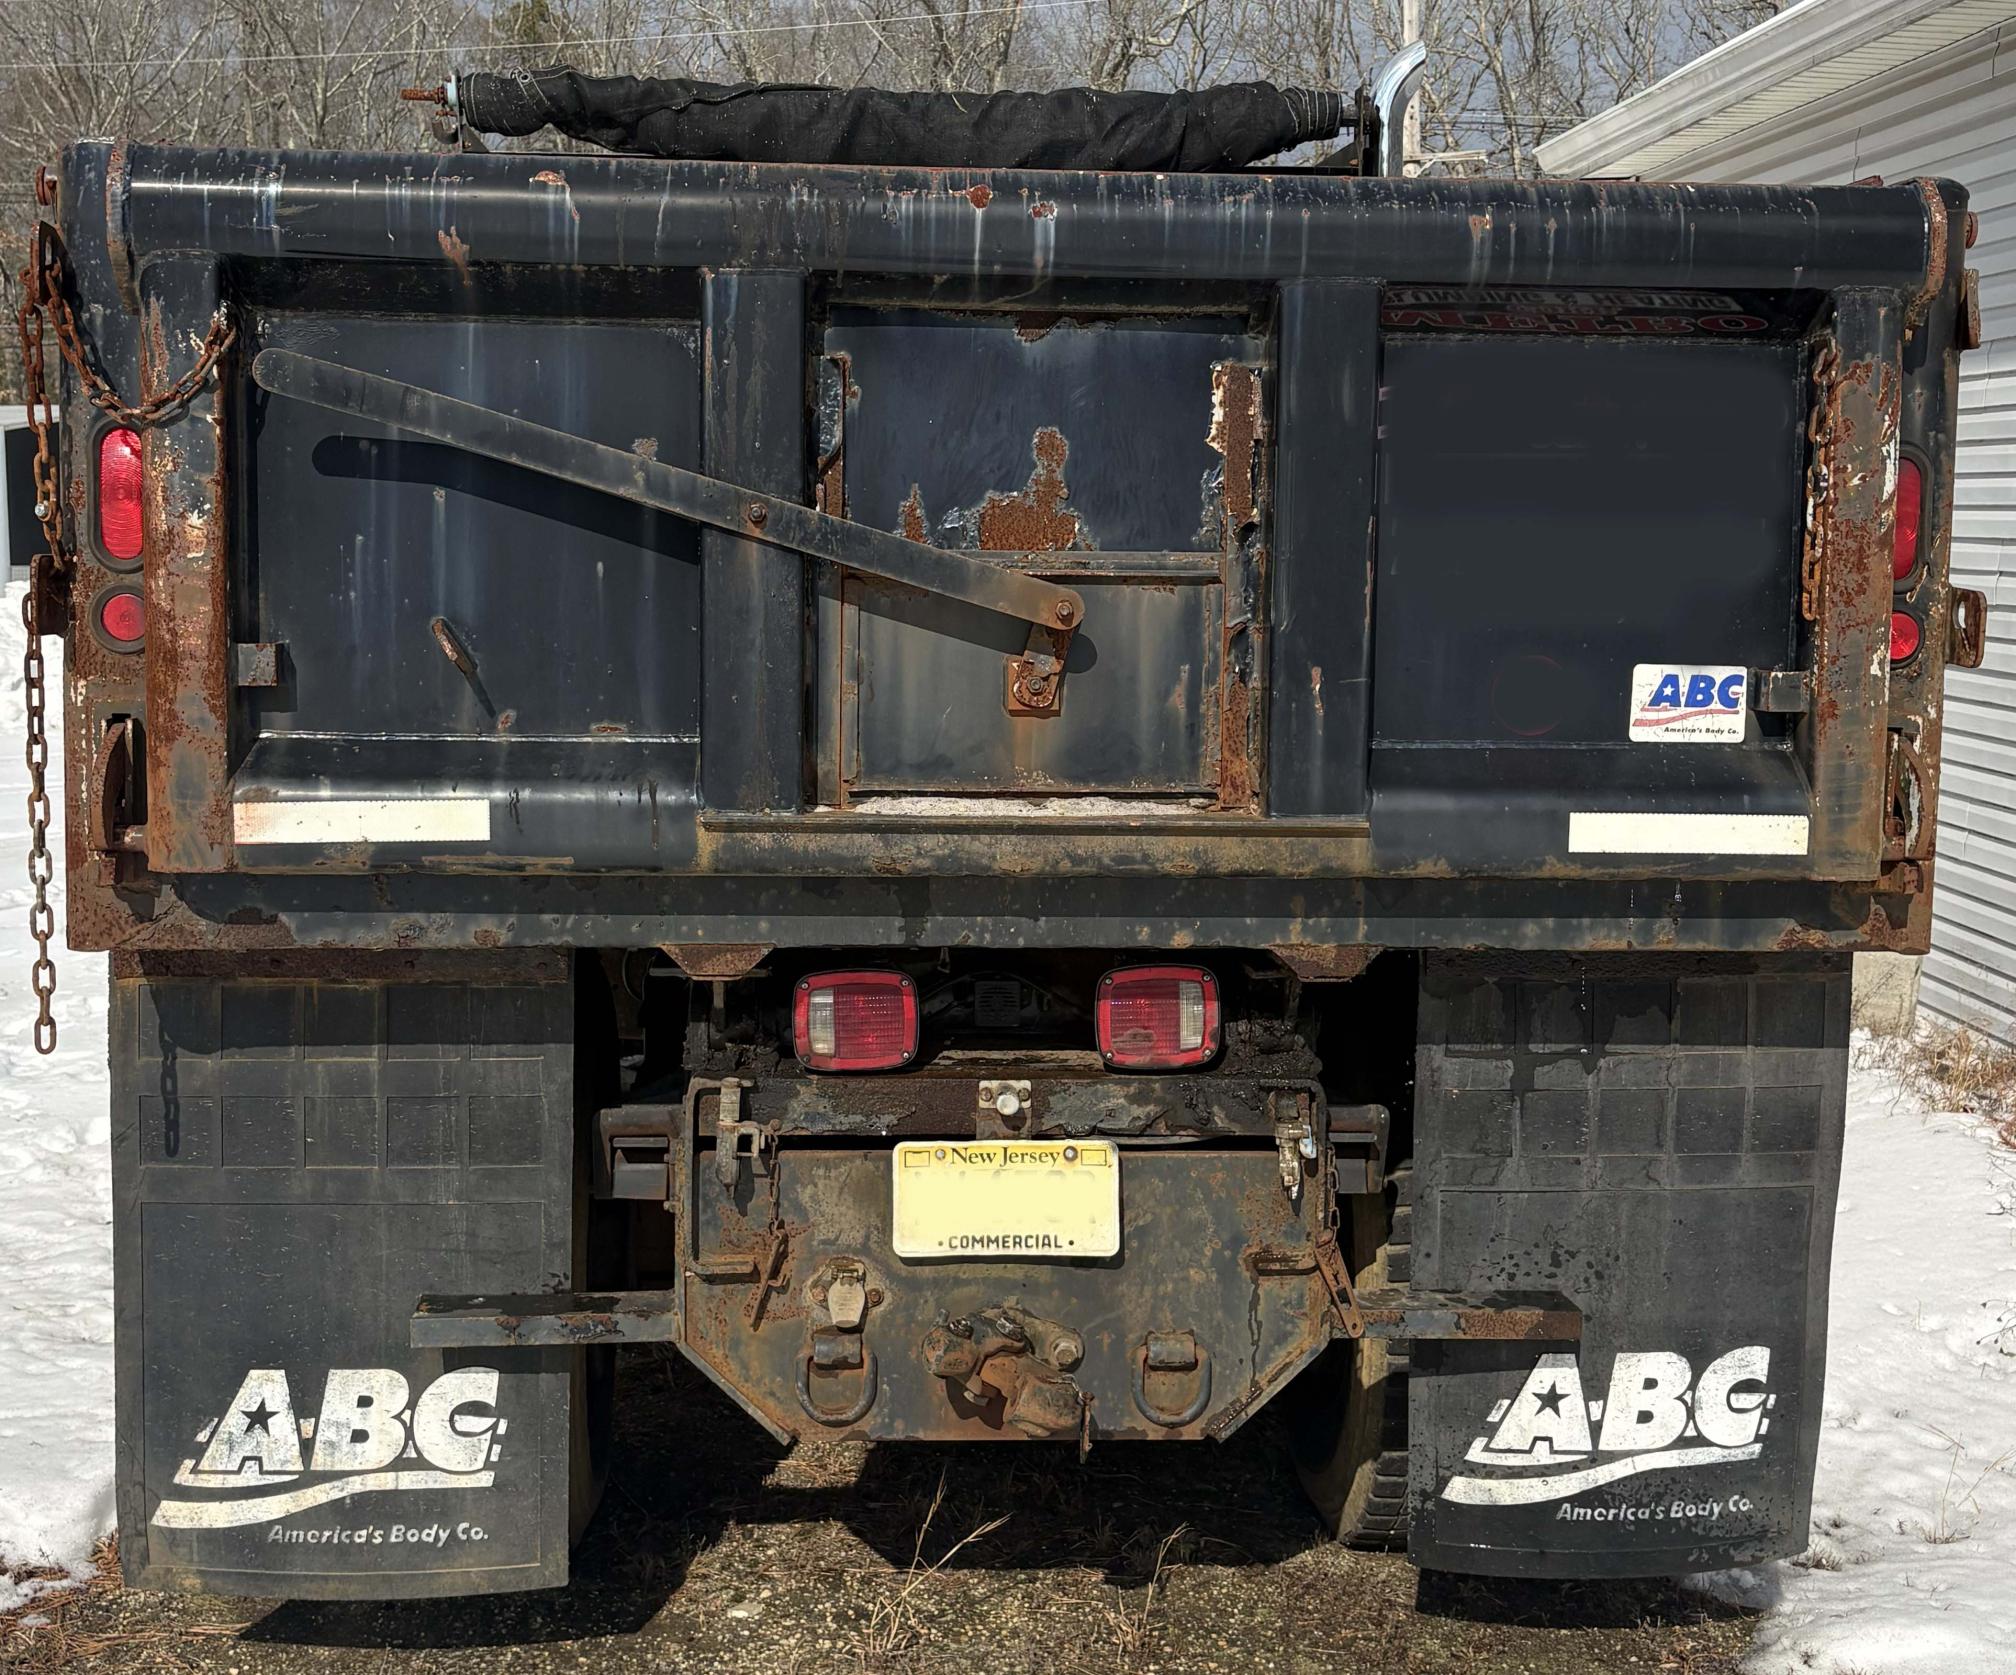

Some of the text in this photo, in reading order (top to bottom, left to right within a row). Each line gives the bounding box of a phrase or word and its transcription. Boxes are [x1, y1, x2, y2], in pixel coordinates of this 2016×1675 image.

[1648, 674, 1745, 709] ABC
[951, 1146, 1060, 1167] New Jersey
[948, 1234, 1063, 1249] COMMERCIAL
[1489, 1345, 1771, 1451] ABC
[198, 1367, 500, 1472] ABC
[1556, 1495, 1753, 1521] America's Body Co.
[268, 1522, 489, 1547] America's Body Co.
